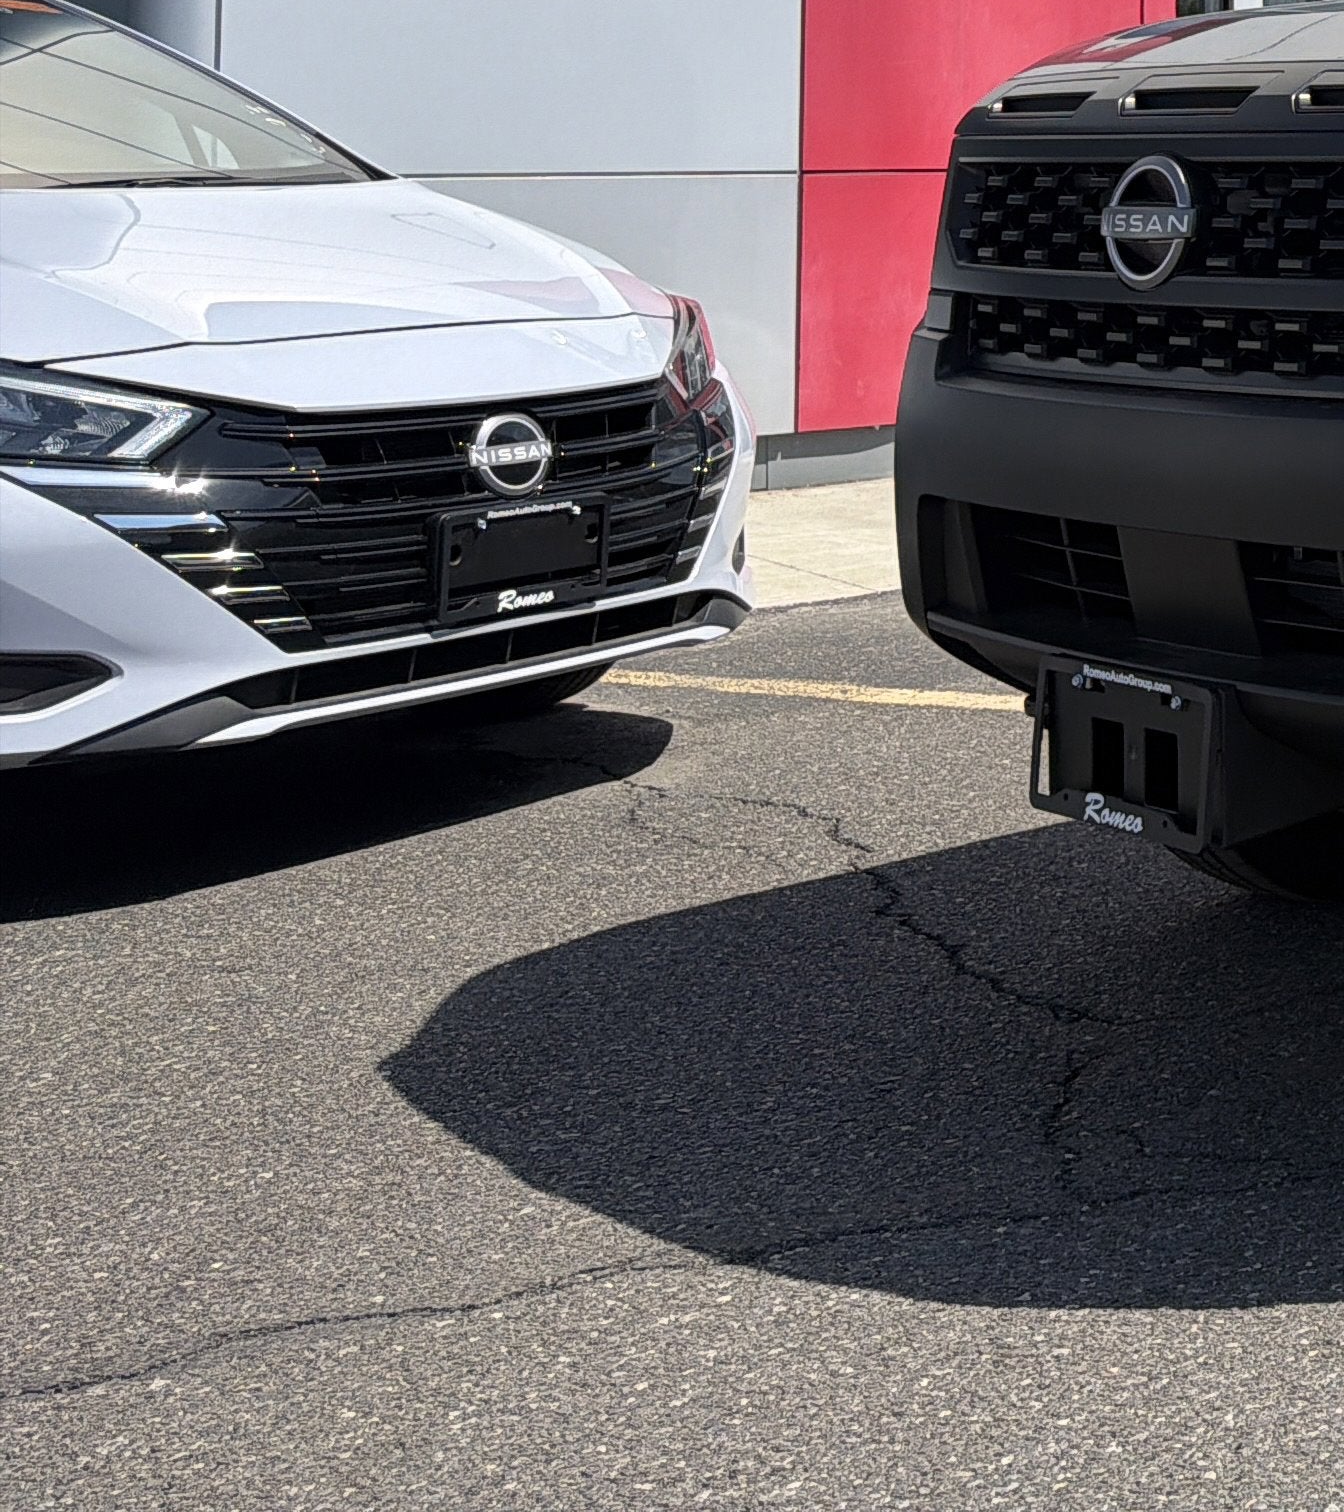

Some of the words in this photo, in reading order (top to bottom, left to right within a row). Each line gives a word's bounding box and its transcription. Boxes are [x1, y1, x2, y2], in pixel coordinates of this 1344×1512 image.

[471, 442, 552, 465] NISSAN
[487, 500, 573, 519] RomeoAutoGroup.com
[497, 589, 555, 613] Romeo
[1083, 663, 1172, 694] RomeoAutoGroup.com
[1084, 792, 1143, 833] Romeo
